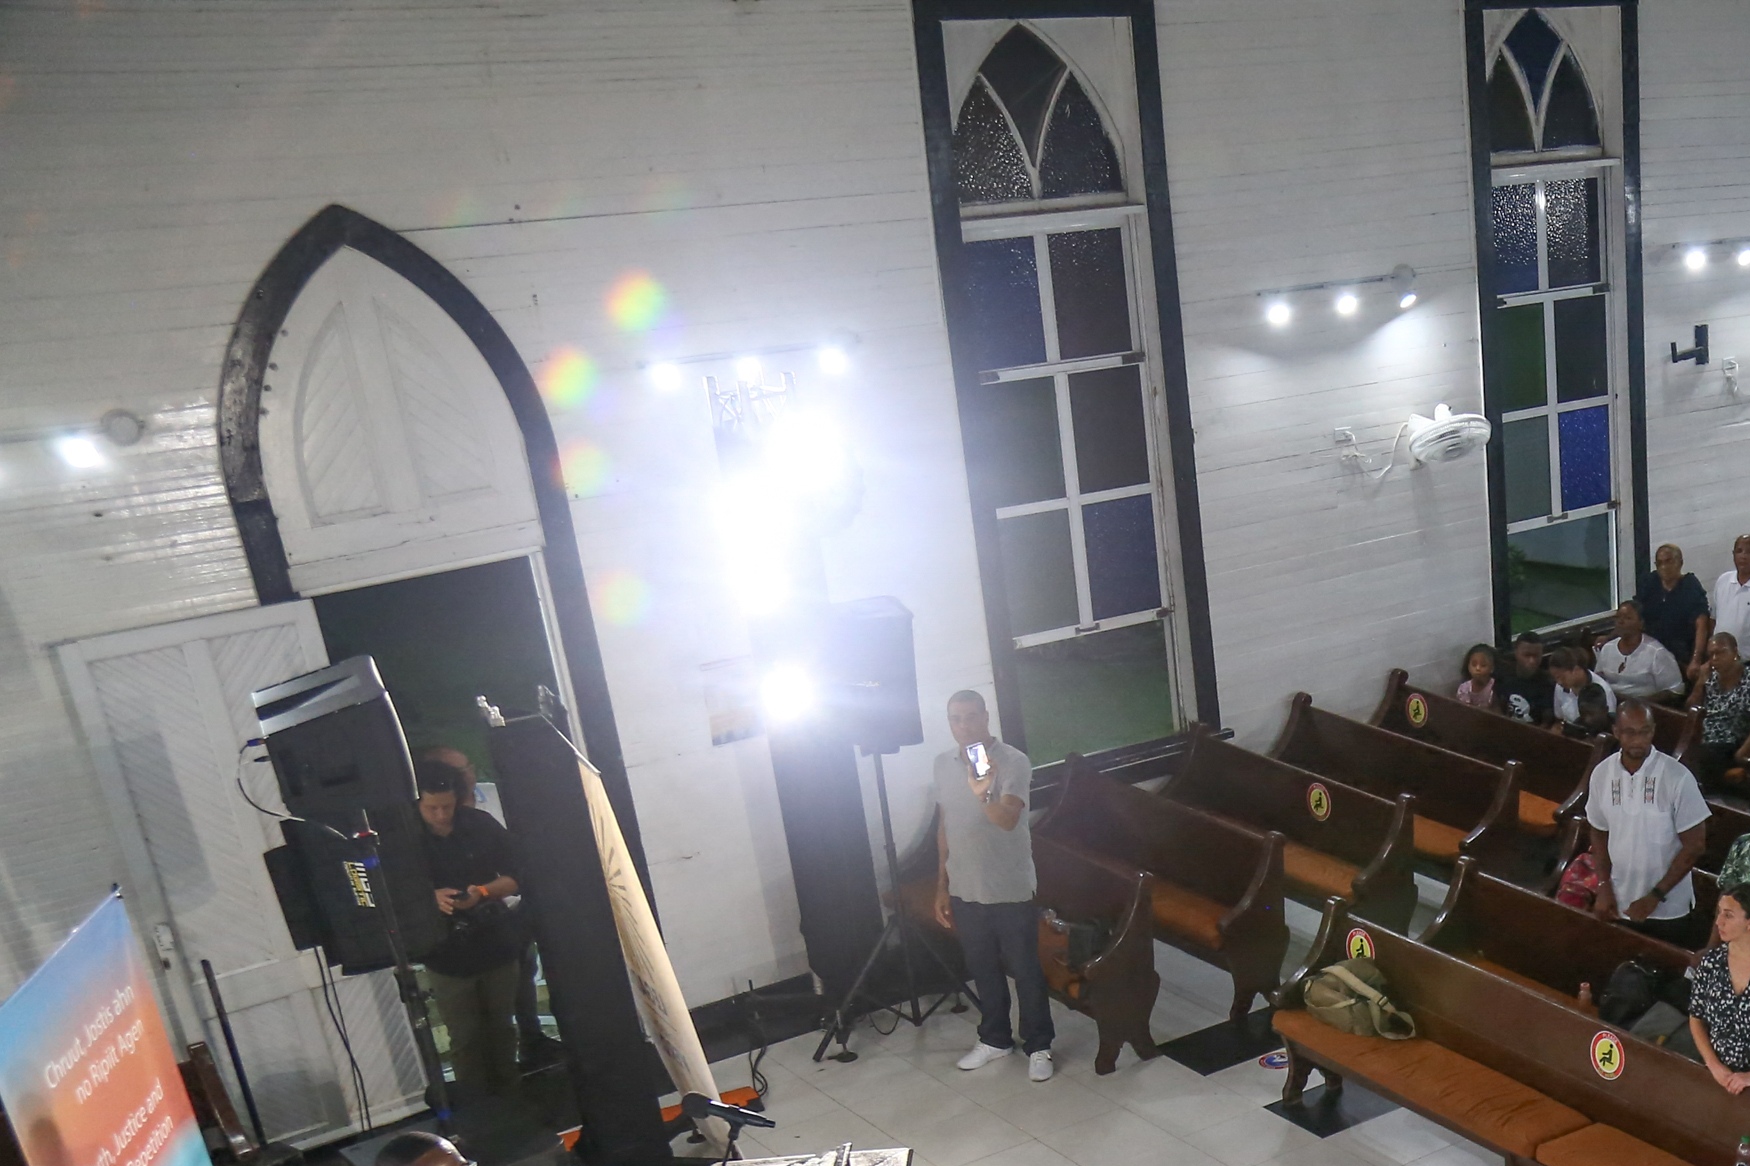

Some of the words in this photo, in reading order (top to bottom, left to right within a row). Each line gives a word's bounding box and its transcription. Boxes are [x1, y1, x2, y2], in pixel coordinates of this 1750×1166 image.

[45, 1036, 87, 1089] Chruut,
[86, 1006, 114, 1047] Jostis
[112, 985, 135, 1014] ahn
[75, 1078, 92, 1104] no
[89, 1042, 120, 1082] Ripiit
[117, 1018, 144, 1055] Agen
[112, 1106, 148, 1155] Justice
[146, 1077, 164, 1108] and
